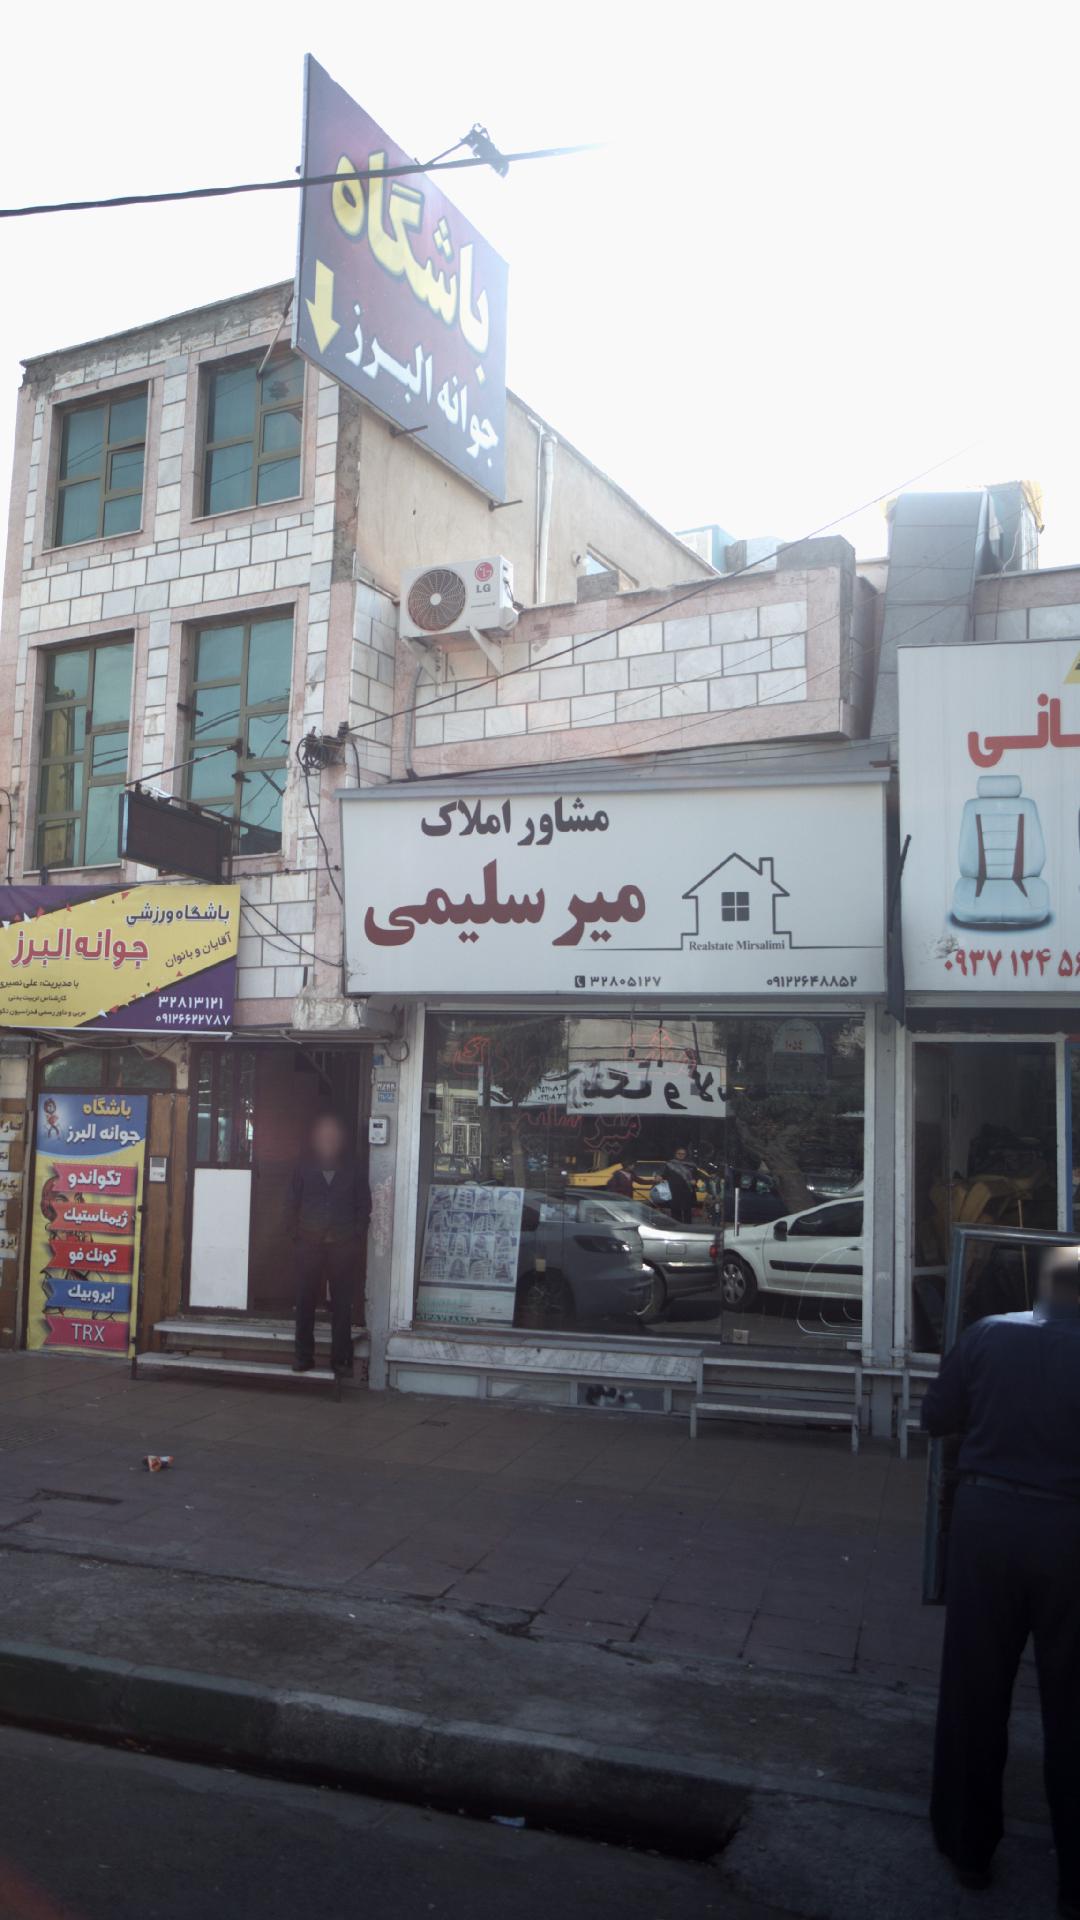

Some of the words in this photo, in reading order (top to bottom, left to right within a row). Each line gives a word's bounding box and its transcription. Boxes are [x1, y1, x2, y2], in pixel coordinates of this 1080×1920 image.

[331, 150, 491, 385] باشگاه
[345, 304, 433, 405] البرز
[437, 376, 498, 467] جوانه
[476, 583, 491, 594] LG
[421, 798, 511, 836] املاک
[517, 797, 610, 846] مشاور
[175, 902, 231, 925] باشگاه
[364, 858, 545, 947] سلیمی
[126, 902, 174, 927] ورزشی
[552, 884, 646, 946] میر
[10, 927, 71, 968] البرز
[75, 928, 148, 969] جوانه
[194, 947, 201, 958] و
[202, 931, 232, 954] آقایان
[689, 940, 734, 951] Realstate
[736, 939, 786, 951] Mirsalimi
[165, 949, 193, 968] بانوان
[590, 975, 662, 987] ۳۲۸۰۵۱۲۷
[766, 975, 857, 988] ۰۹۱۲۲۶۴۸۸۵۲
[158, 996, 223, 1010] ۳۲۸۱۳۱۲۱
[155, 1013, 231, 1026] ۰۹۱۲۶۶۲۲۷۸۷
[82, 1096, 132, 1119] باشگاه
[66, 1123, 97, 1143] البرز
[99, 1124, 140, 1145] جوانه
[67, 1168, 122, 1190] تکواندو
[69, 1247, 84, 1265] فو
[71, 1322, 105, 1343] TRX
